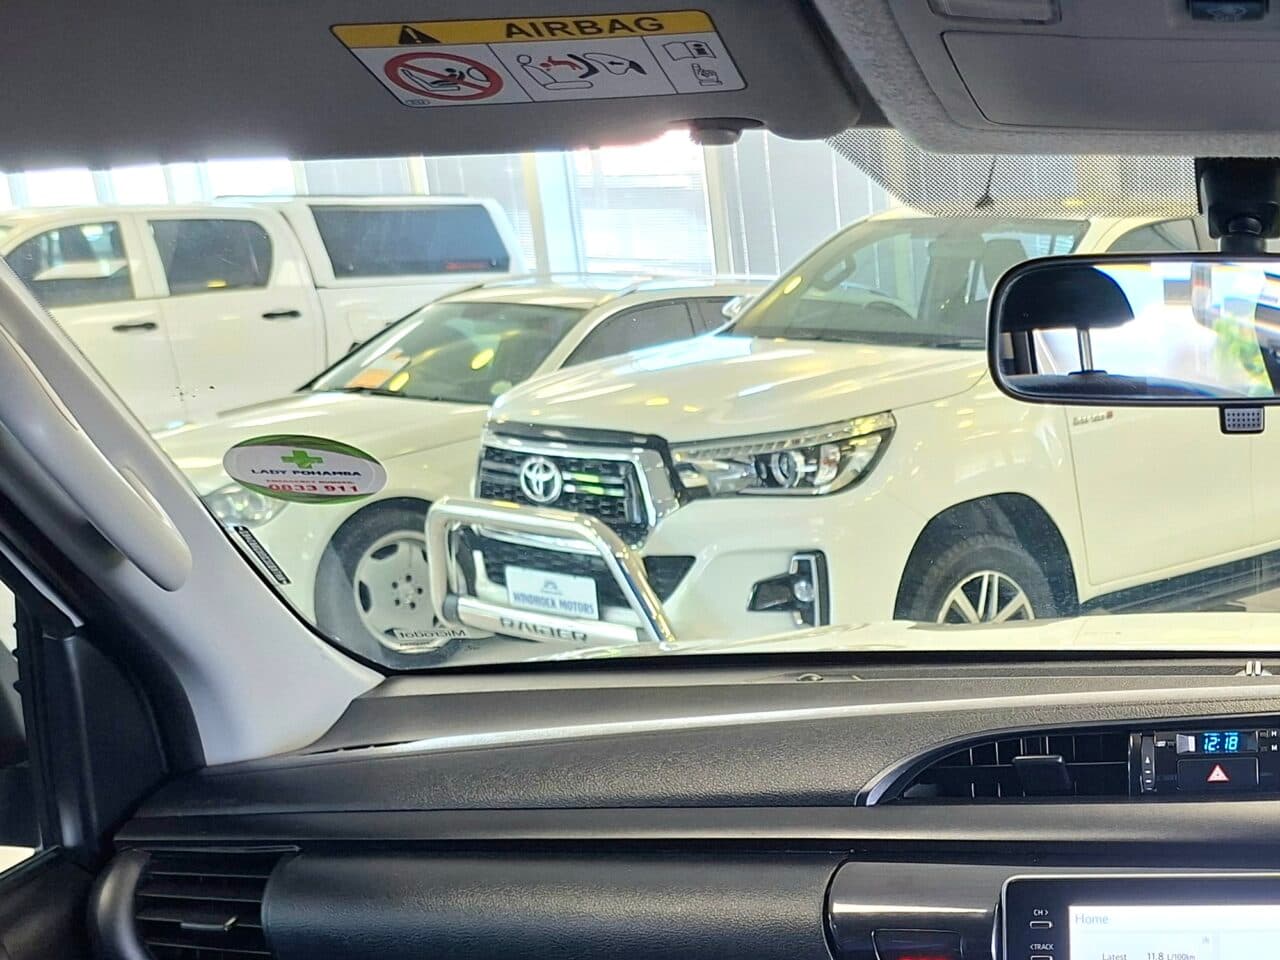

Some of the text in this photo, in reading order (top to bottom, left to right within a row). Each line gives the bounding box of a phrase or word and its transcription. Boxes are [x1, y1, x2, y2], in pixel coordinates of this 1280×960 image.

[505, 16, 665, 39] AIRBAG
[292, 469, 362, 477] POHAMBA
[323, 485, 359, 493] 911
[559, 599, 594, 615] MOTORS
[1203, 733, 1239, 751] 12:18
[1075, 913, 1109, 925] Home
[1102, 953, 1127, 960] Latest
[1147, 952, 1164, 960] 11.8
